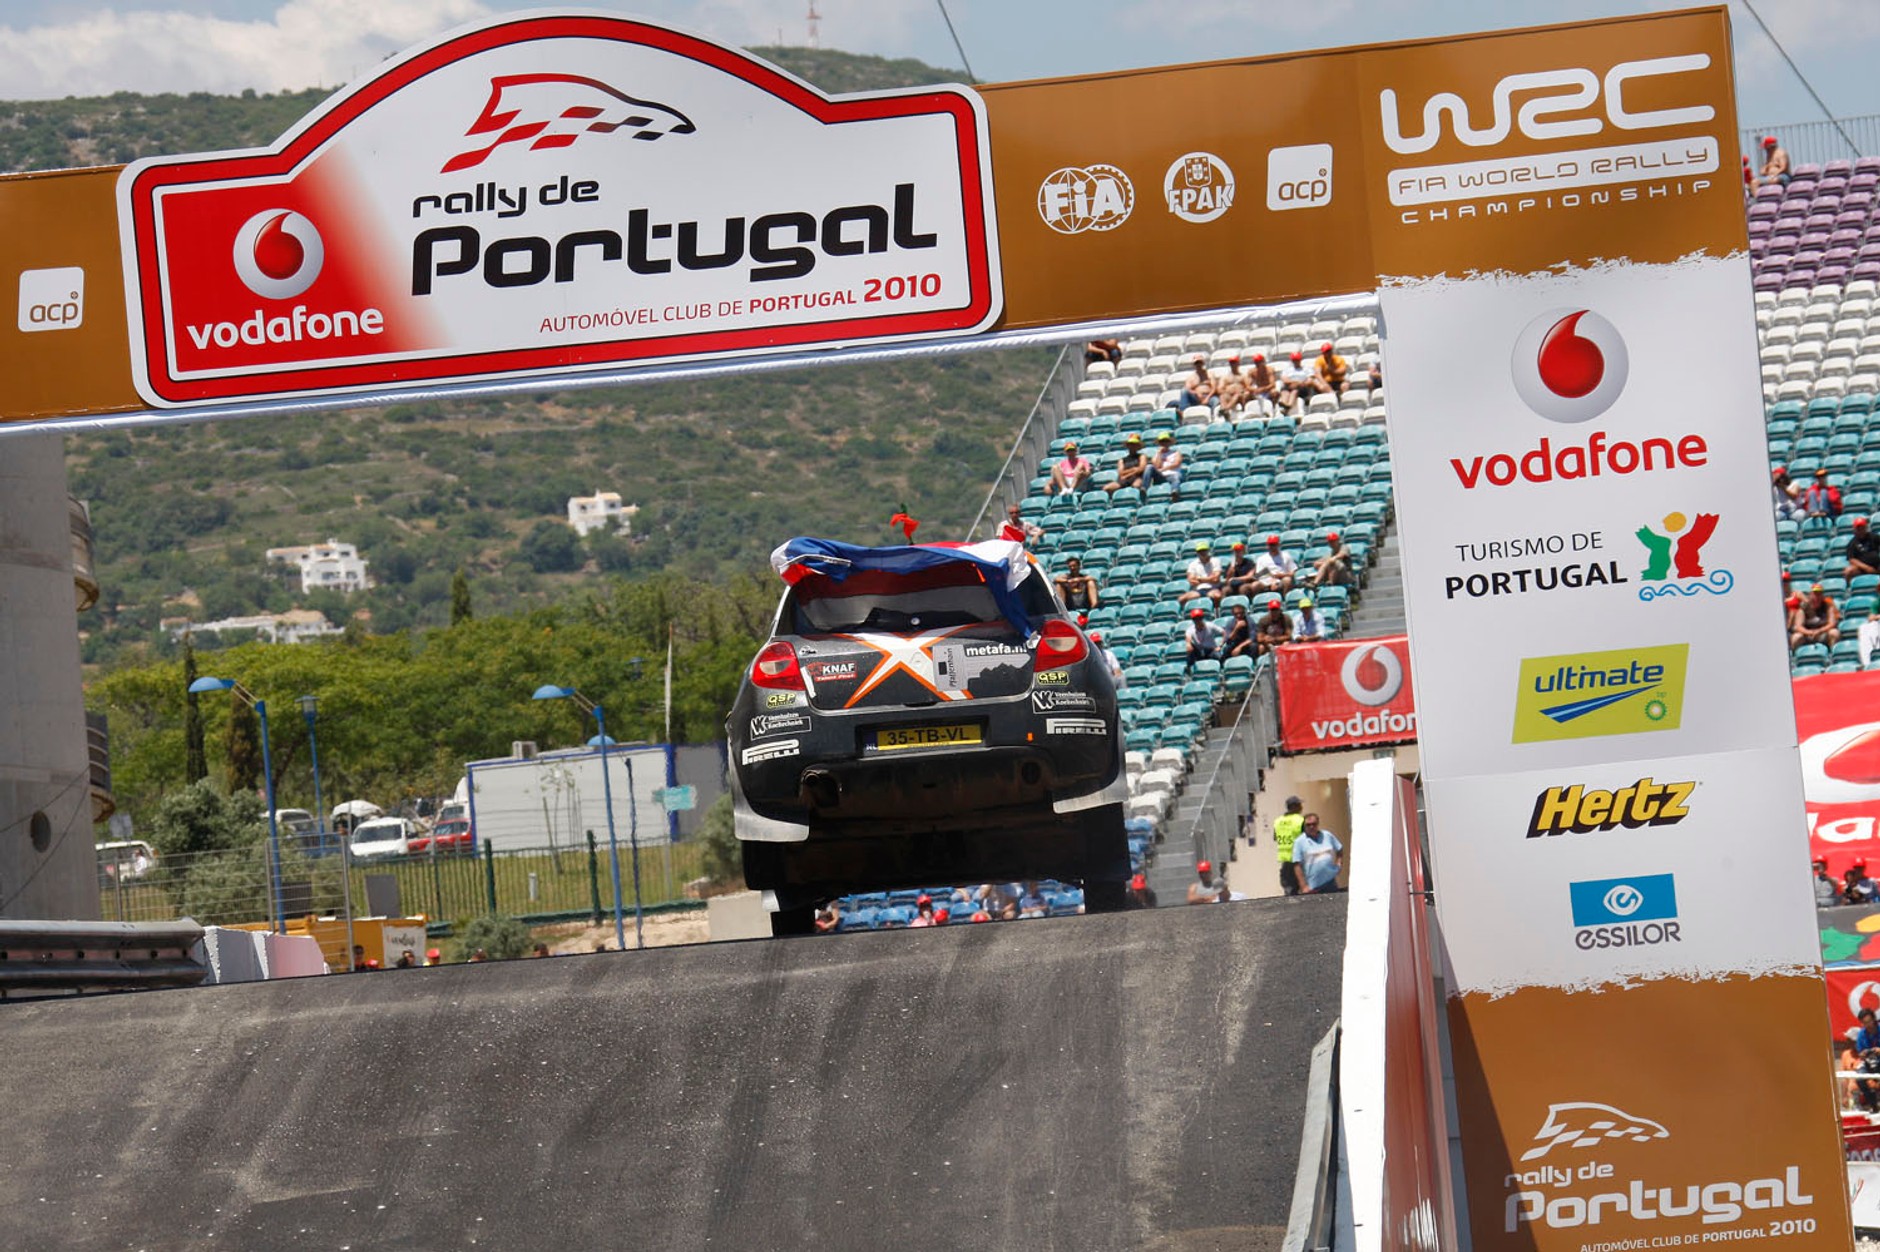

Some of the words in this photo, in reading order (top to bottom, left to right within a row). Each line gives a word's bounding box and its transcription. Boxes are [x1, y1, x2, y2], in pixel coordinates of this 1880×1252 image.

[1380, 53, 1716, 154] WRC
[1398, 175, 1447, 195] FIA
[1457, 161, 1579, 188] WORLD
[1590, 147, 1708, 174] RALLY
[412, 181, 527, 218] rally
[539, 175, 600, 204] de
[1168, 183, 1234, 213] FPAK
[1278, 179, 1328, 202] acp
[1401, 180, 1711, 224] CHAMPIONSHIP
[411, 182, 938, 296] Portugal
[29, 300, 79, 325] acp
[540, 307, 659, 334] AUTOMÓVEL
[663, 303, 713, 322] CLUB
[718, 300, 743, 318] DE
[749, 289, 857, 314] PORTUGAL
[863, 273, 942, 302] 2010
[187, 305, 385, 349] vodafone
[1450, 432, 1708, 489] vodafone
[1456, 534, 1564, 562] TURISMO
[1572, 531, 1604, 552] DE
[1445, 561, 1628, 600] PORTUGAL
[823, 663, 855, 675] KNAF
[1039, 672, 1067, 683] QSP
[1535, 660, 1665, 693] ultimate
[887, 727, 971, 746] 35-TB-VL
[1046, 718, 1107, 736] PIRELLI
[1311, 709, 1416, 740] vodafon
[742, 739, 800, 766] PIRELLI
[1526, 777, 1697, 839] Hertz
[1504, 1165, 1572, 1188] rally
[1578, 1161, 1614, 1180] de
[1505, 1166, 1813, 1233] Portugal
[1580, 1239, 1650, 1252] AUTOMÓVEL
[1651, 1235, 1682, 1248] CLUB
[1684, 1234, 1700, 1244] DE
[1702, 1228, 1767, 1243] PORTUGAL
[1769, 1218, 1817, 1237] 2010
